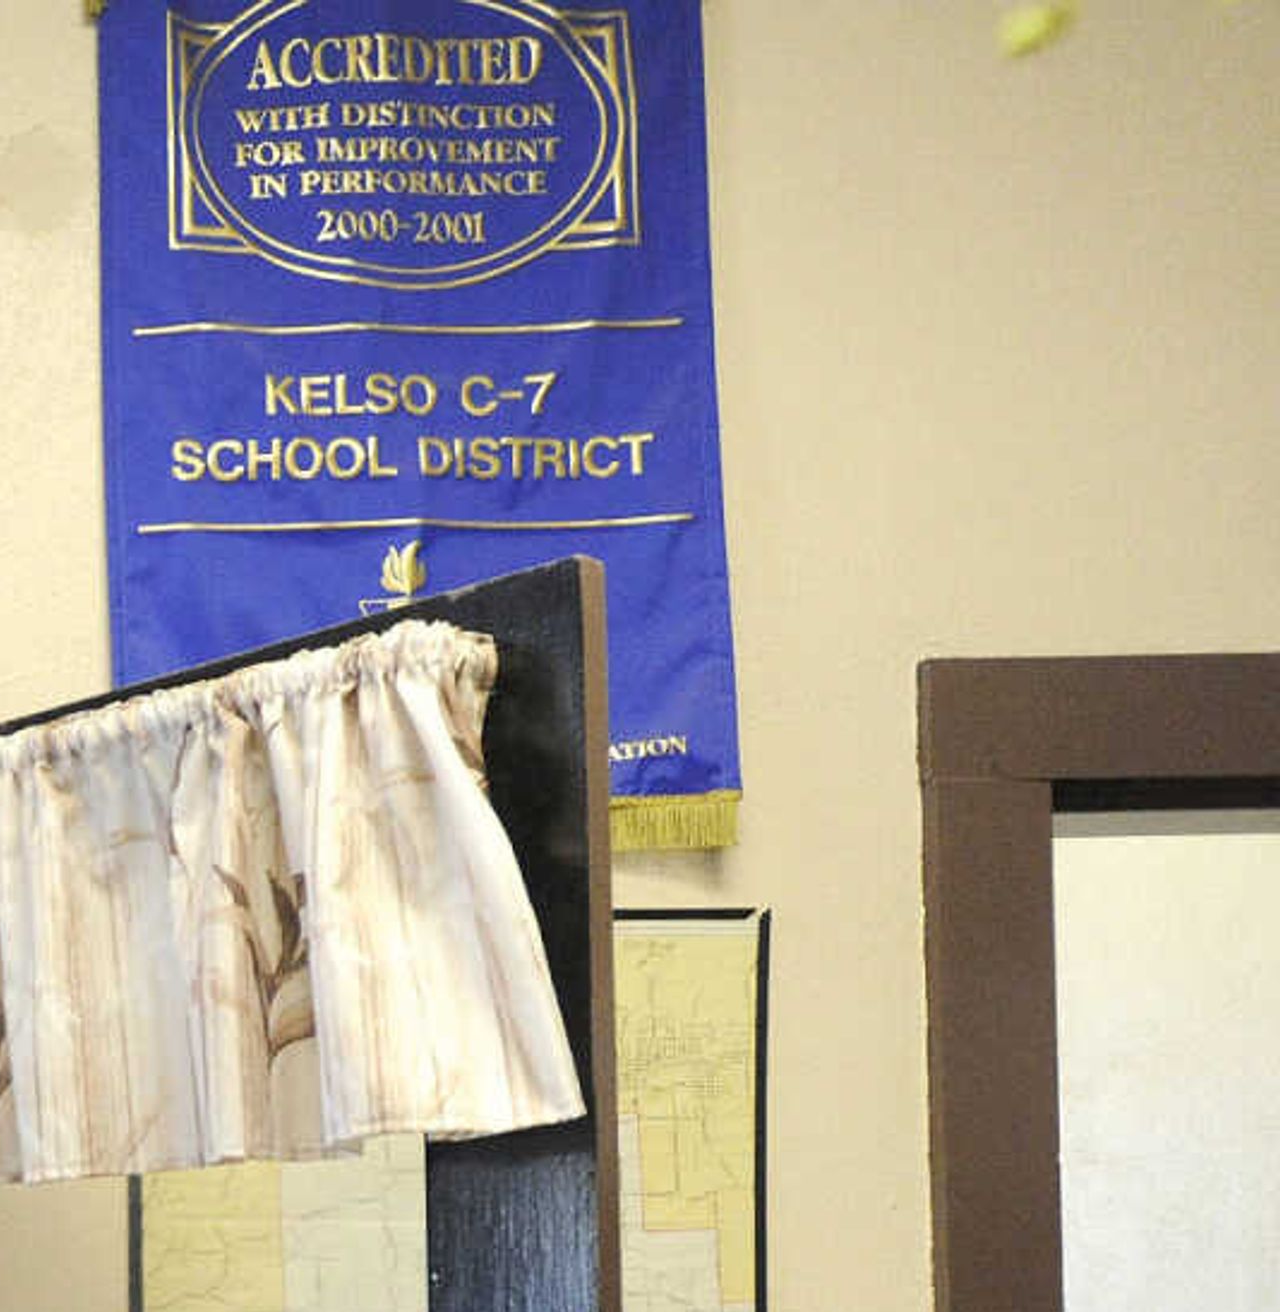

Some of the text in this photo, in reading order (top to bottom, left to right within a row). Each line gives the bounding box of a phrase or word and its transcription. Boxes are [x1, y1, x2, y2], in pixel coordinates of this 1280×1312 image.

[245, 31, 542, 90] ACCREDITED
[235, 99, 556, 134] WITH DISTINCTION
[235, 136, 562, 167] FOR IMPROVEMENT
[249, 169, 548, 199] IN PERFORMANCE
[315, 209, 486, 243] 2000-2001
[265, 373, 556, 416] KELSO C-7
[171, 433, 654, 481] SCHOOL DISTRICT
